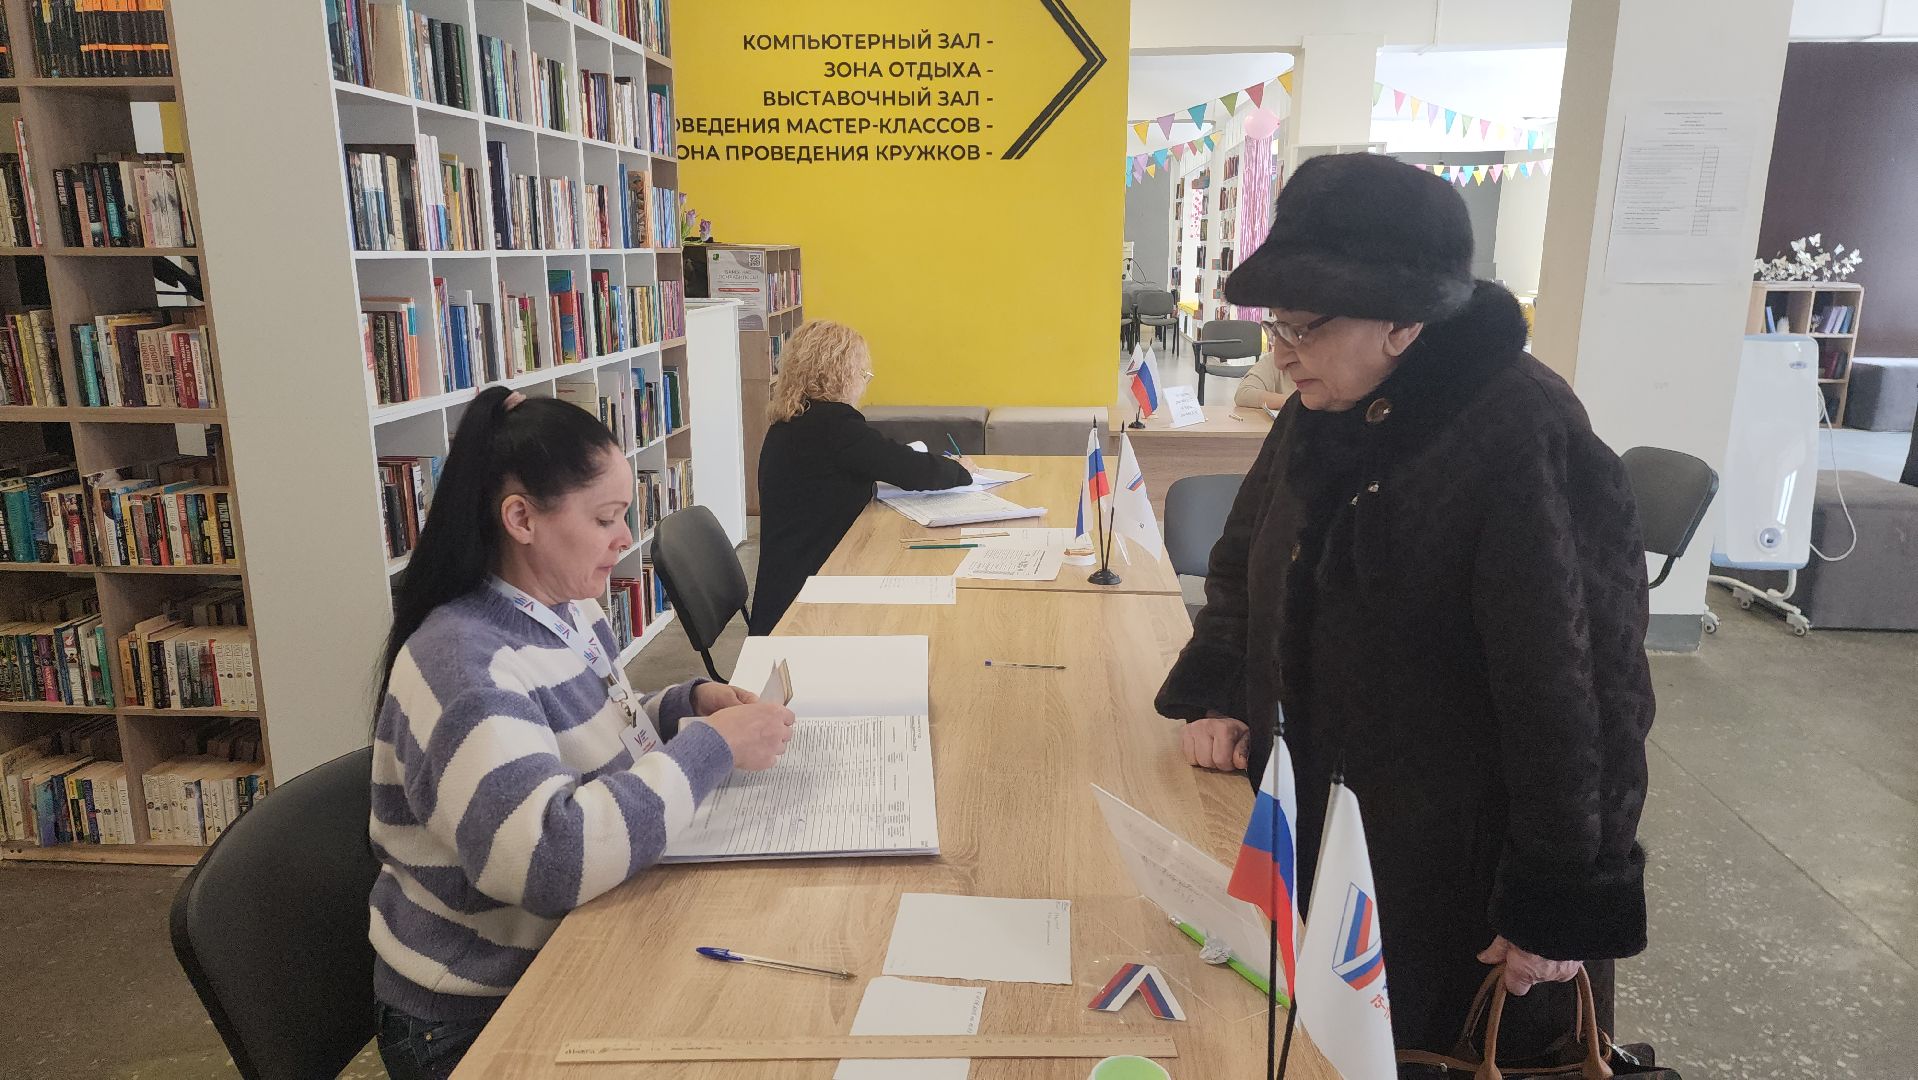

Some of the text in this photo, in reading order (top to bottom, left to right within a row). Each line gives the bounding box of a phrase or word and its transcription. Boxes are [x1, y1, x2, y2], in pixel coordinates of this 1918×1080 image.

[743, 29, 932, 51] КОМПЬЮТЕРНЫЙ
[937, 32, 980, 50] ЗАЛ
[824, 61, 884, 78] ЗОНА
[888, 61, 982, 81] ОТДЫХА
[763, 86, 931, 107] ВЫСТАВОЧНЫЙ
[937, 90, 979, 107] ЗАЛ
[786, 117, 981, 134] МАСТЕР-КЛАССОВ
[725, 145, 869, 164] ПРОВЕДЕНИЯ
[876, 144, 981, 161] КРУЖКОВ
